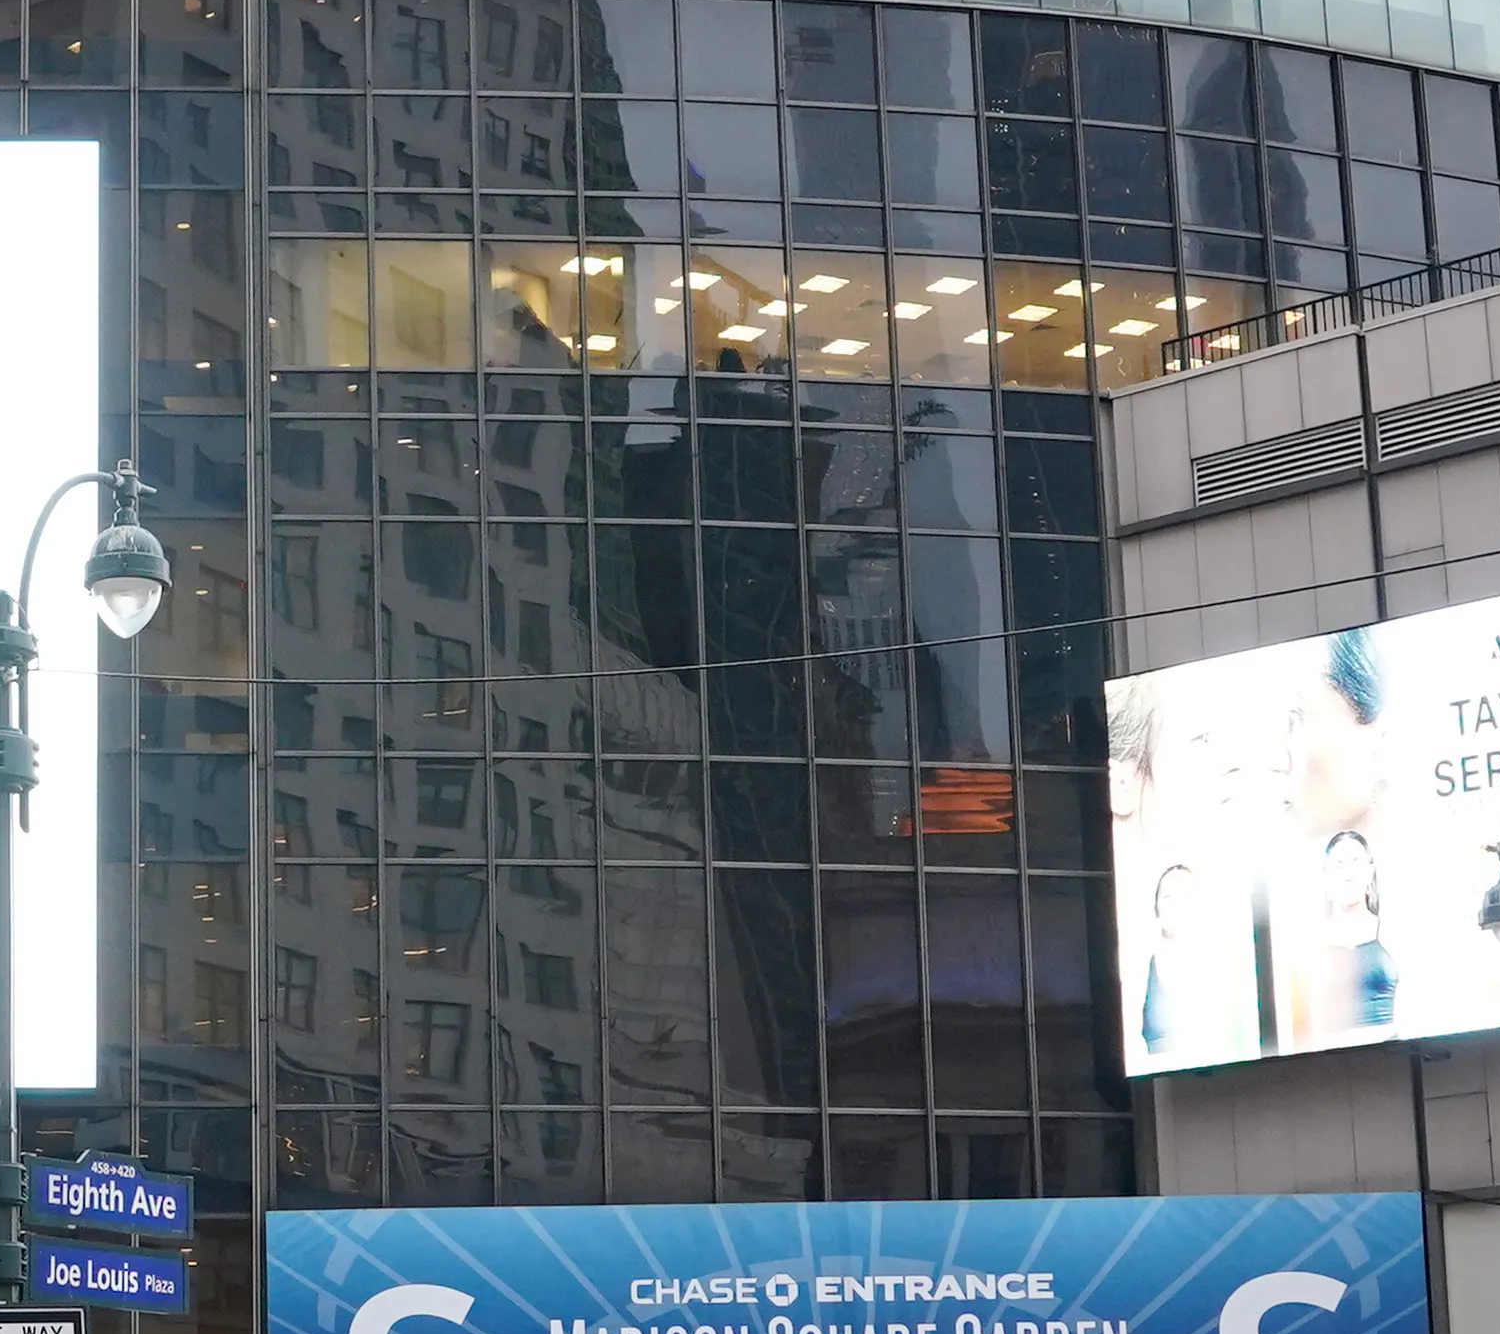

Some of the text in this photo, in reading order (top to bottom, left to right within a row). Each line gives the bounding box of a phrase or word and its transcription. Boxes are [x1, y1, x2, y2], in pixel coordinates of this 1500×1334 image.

[91, 1161, 136, 1179] 458 420
[48, 1173, 176, 1219] Eighth Ave
[47, 1255, 175, 1295] Joe Louis Plaza
[629, 1272, 1054, 1307] CHASE ENTRANCE
